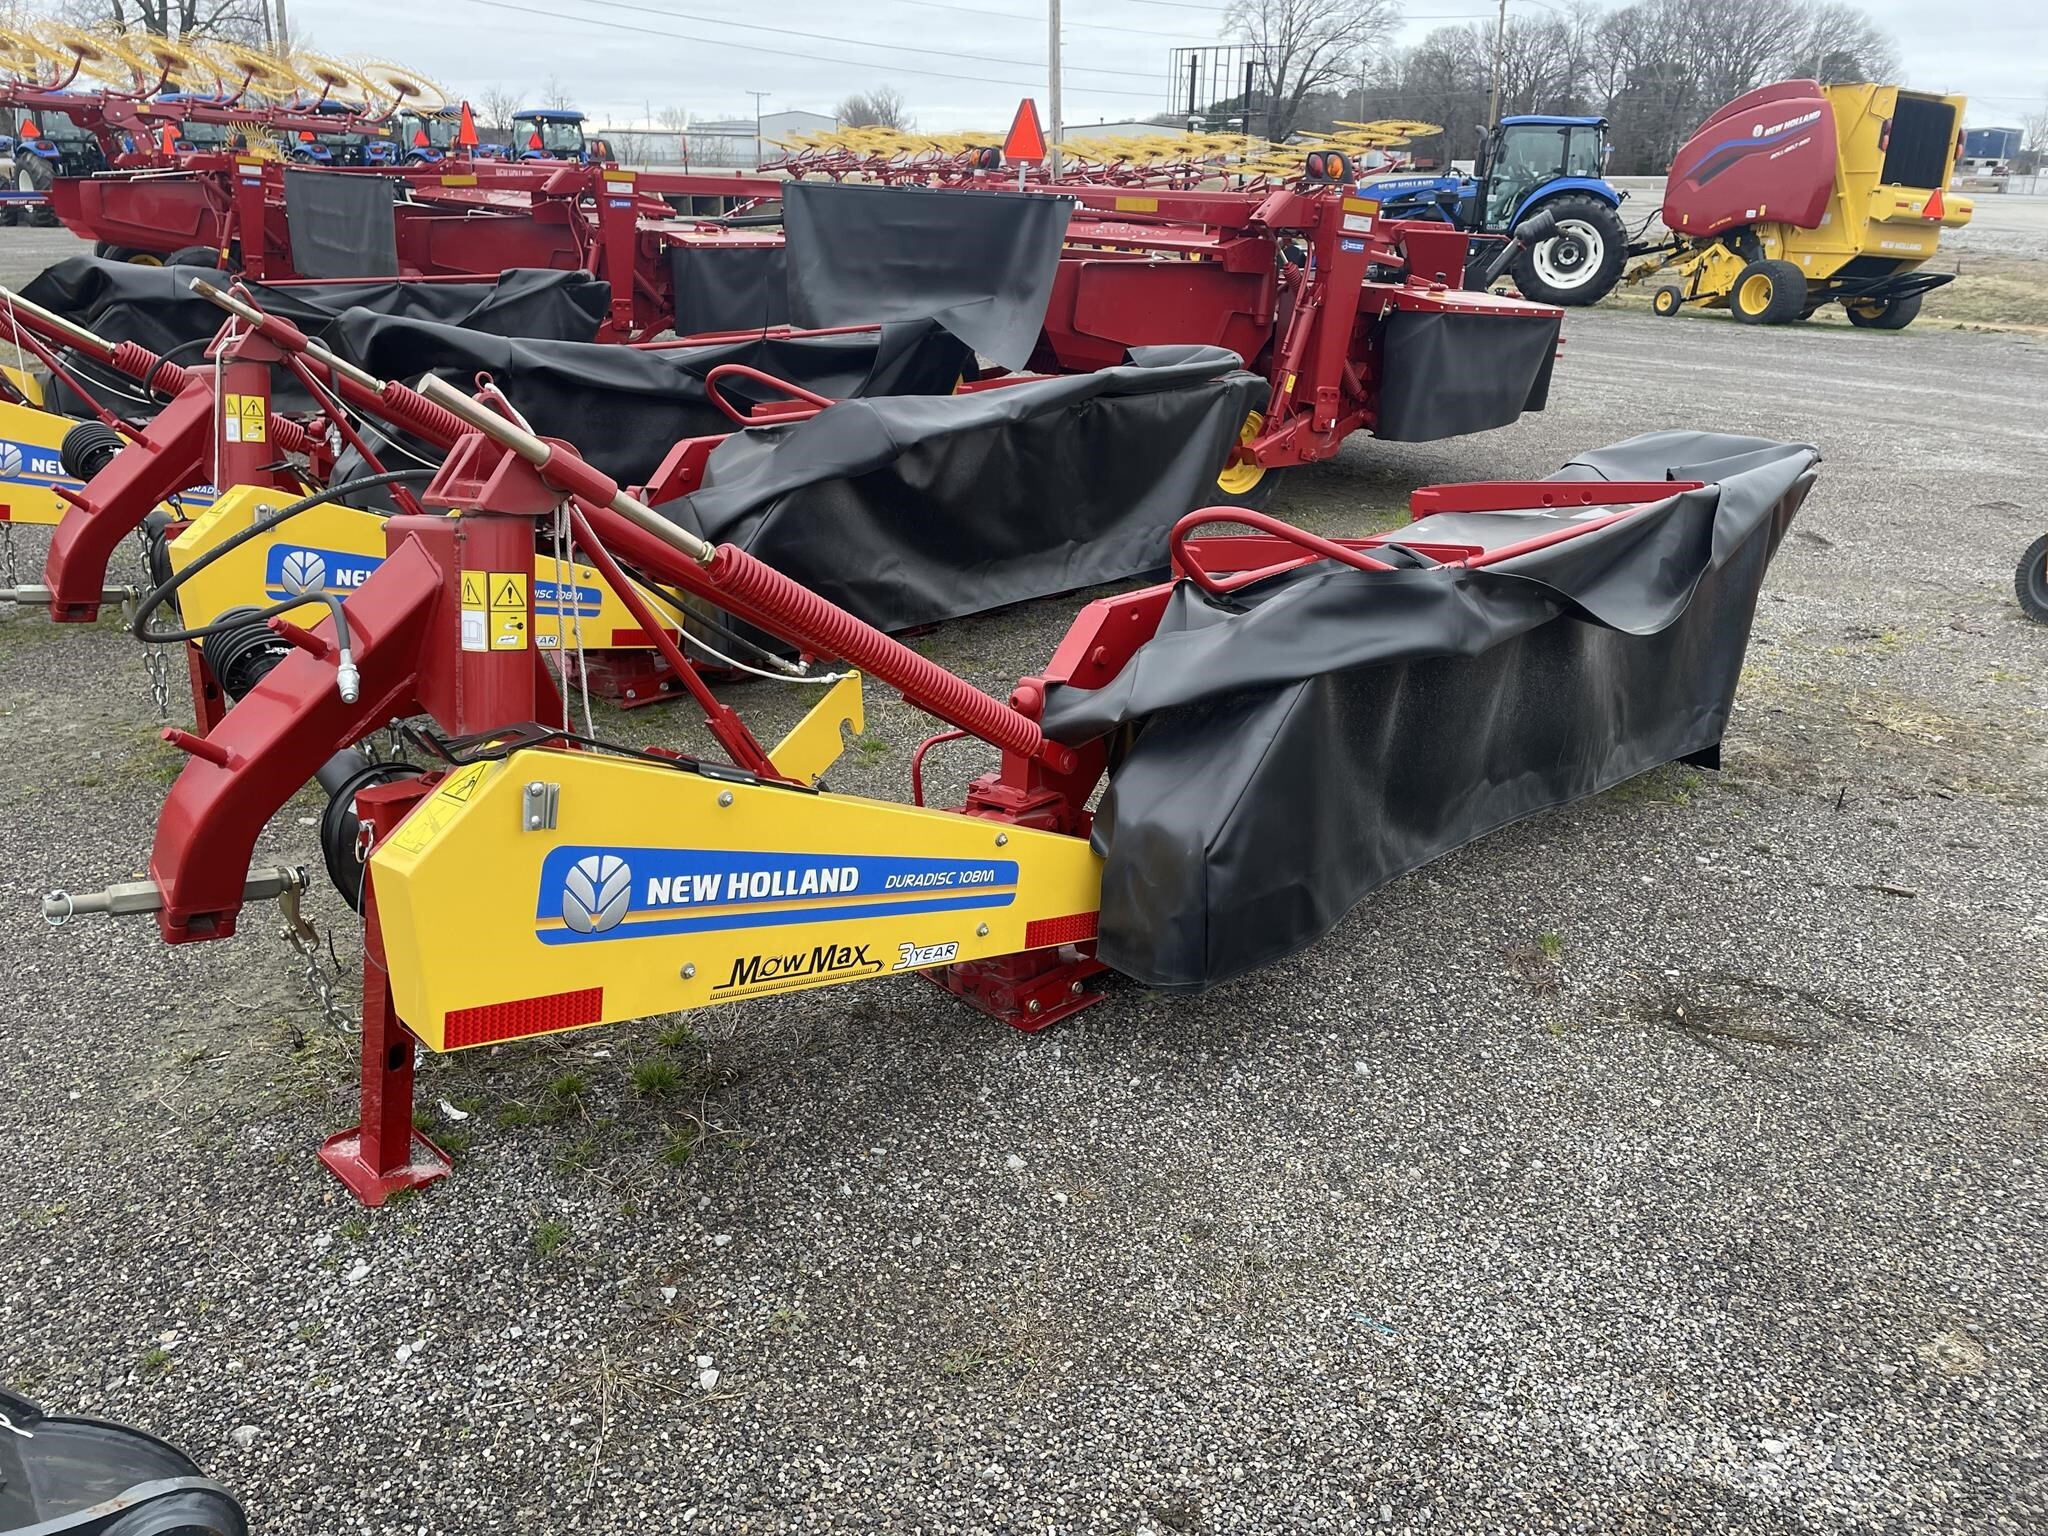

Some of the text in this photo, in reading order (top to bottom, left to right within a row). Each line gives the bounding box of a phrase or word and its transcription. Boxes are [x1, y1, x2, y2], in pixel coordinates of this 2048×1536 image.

[1764, 110, 1821, 136] NEW HOLLAND
[1378, 180, 1435, 190] NEW HOLLAND
[647, 867, 860, 905] NEW HOLLAND
[884, 869, 995, 889] DURADISC 108M
